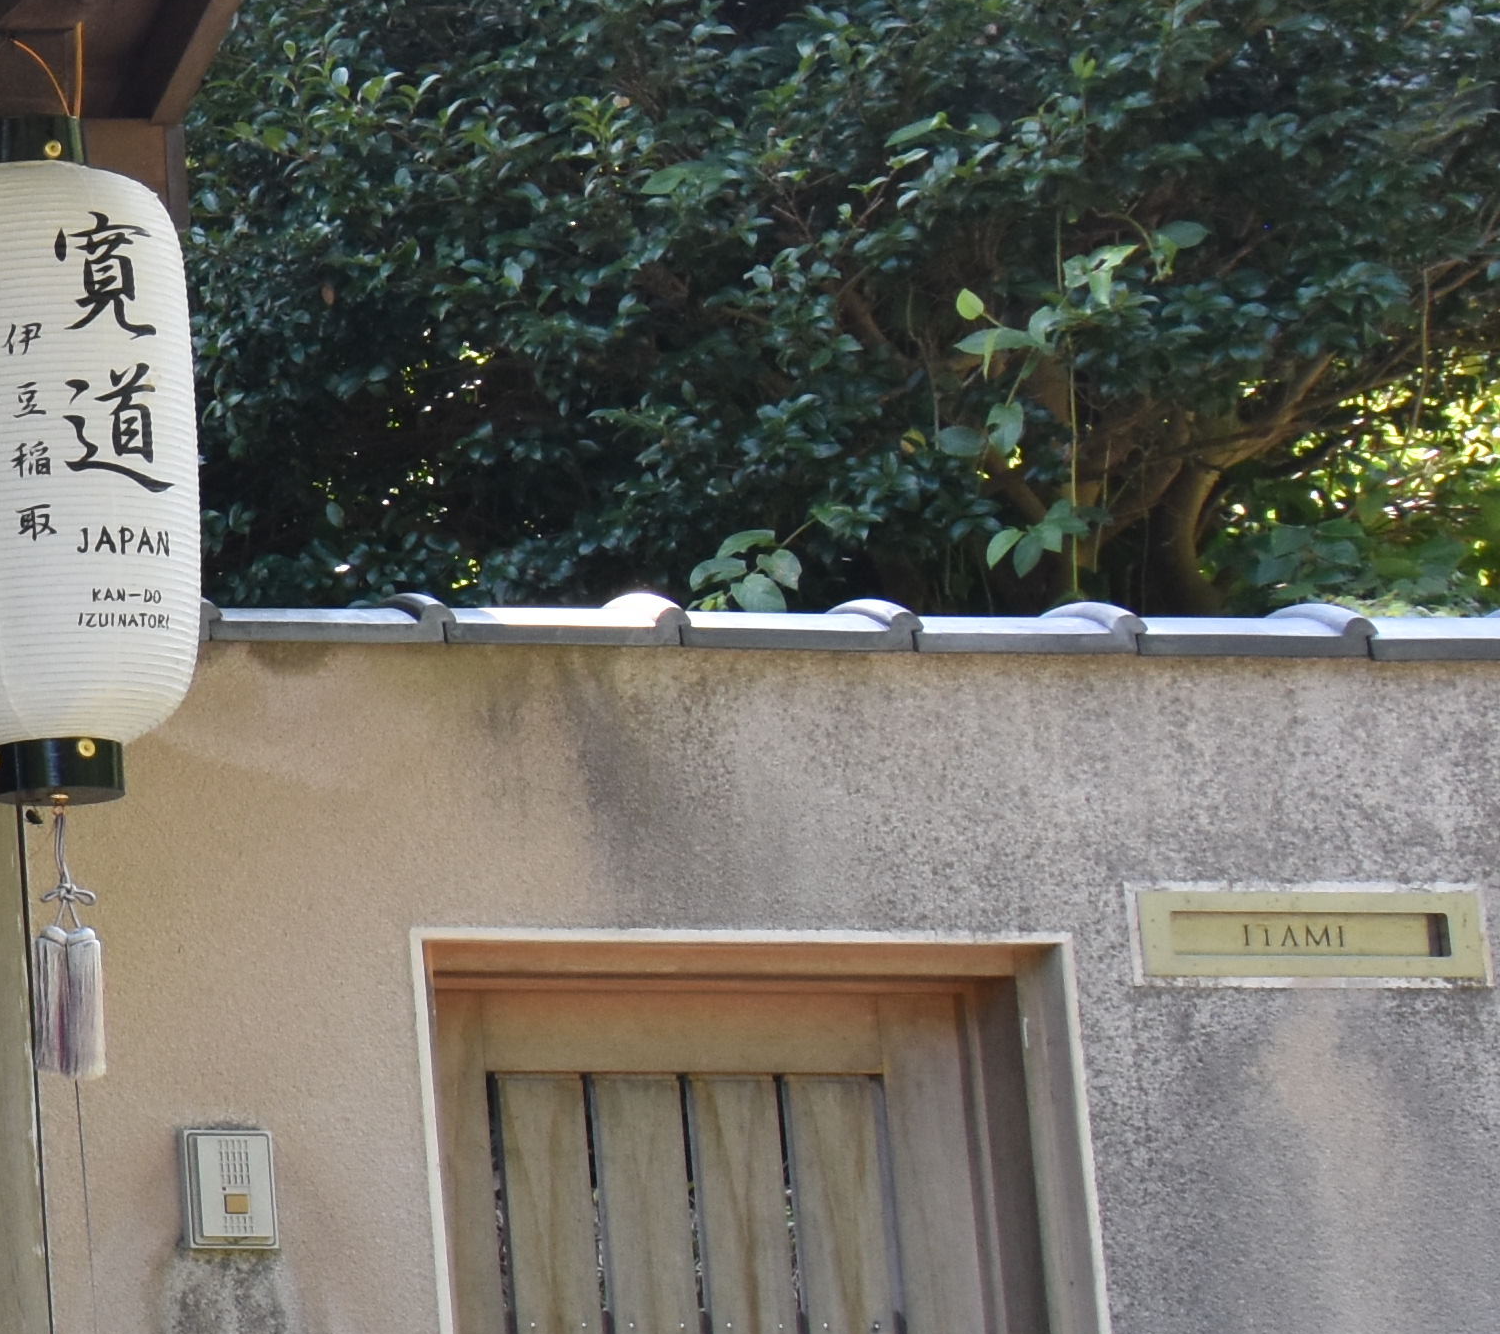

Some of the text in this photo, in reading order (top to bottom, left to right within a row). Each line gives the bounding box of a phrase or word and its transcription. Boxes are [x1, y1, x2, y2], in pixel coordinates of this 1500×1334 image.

[76, 525, 170, 558] JAPAN
[77, 612, 170, 630] IZUINATORI
[1243, 924, 1345, 949] ITAMI
